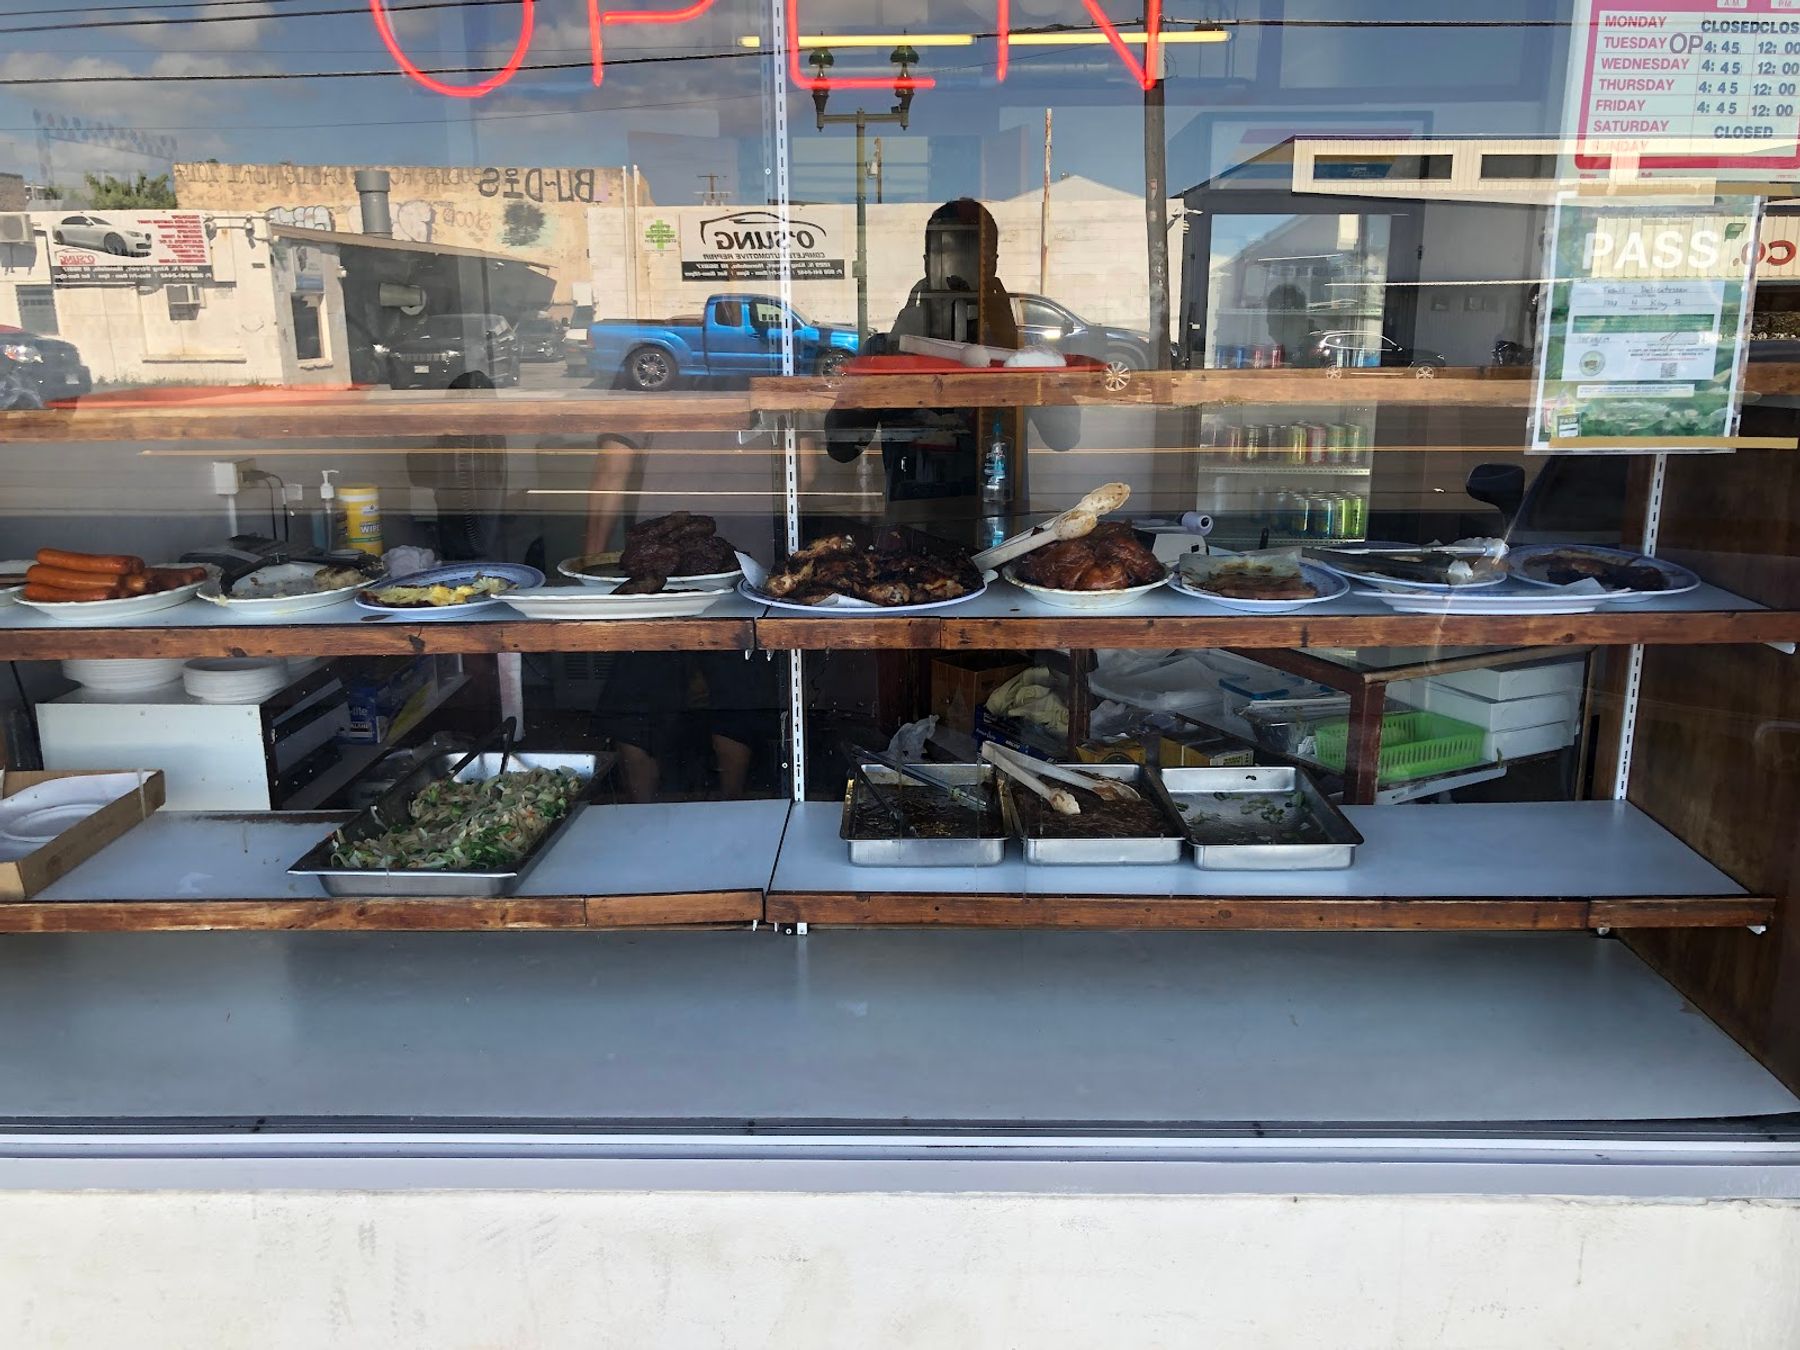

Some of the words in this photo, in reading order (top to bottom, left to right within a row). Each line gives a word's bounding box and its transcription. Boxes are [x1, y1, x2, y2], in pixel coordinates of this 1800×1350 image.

[1605, 16, 1667, 28] MONDAY
[1604, 37, 1667, 49] TUESDAY
[1602, 58, 1690, 70] WEDNESDAY
[1599, 79, 1675, 91] THURSDAY
[1596, 100, 1646, 111] FRIDAY
[1594, 120, 1669, 132] SATURDAY
[1714, 126, 1773, 139] CLOSED
[1582, 230, 1720, 269] PASS
[1559, 416, 1578, 425] PASS
